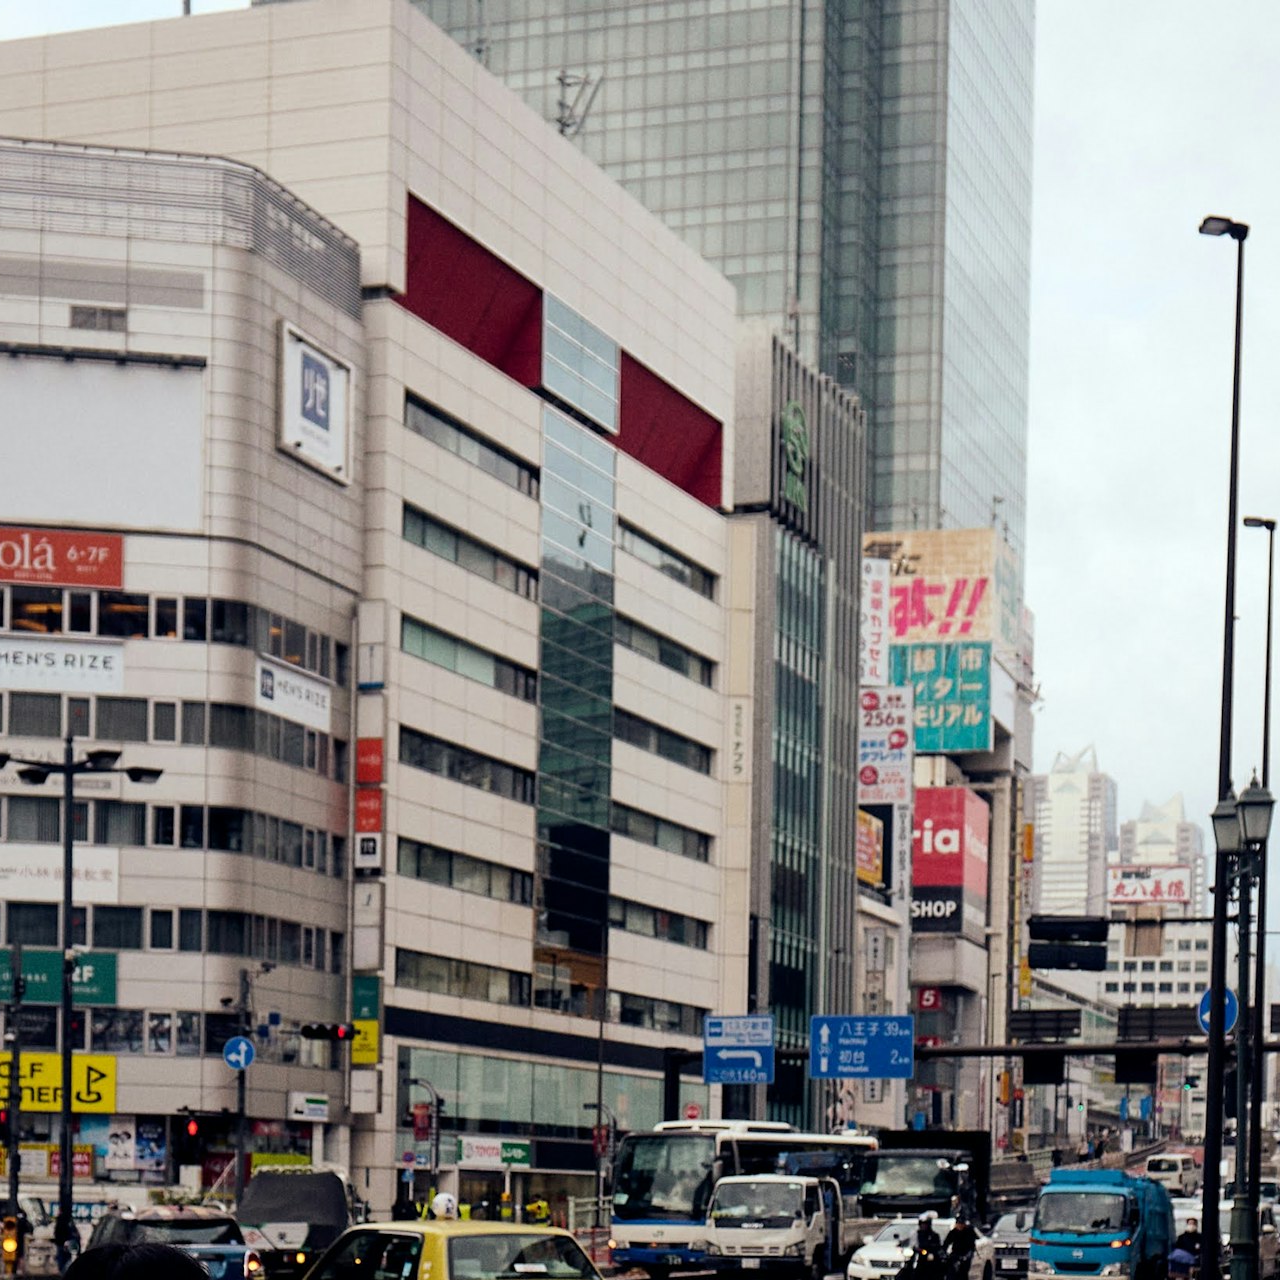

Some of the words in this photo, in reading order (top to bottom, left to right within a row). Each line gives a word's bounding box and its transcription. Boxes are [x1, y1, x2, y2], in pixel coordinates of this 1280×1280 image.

[64, 653, 113, 670] RIZE
[911, 899, 957, 918] SHOP
[922, 989, 934, 1006] 5
[838, 1021, 880, 1037] 八王子
[838, 1051, 866, 1065] 初台
